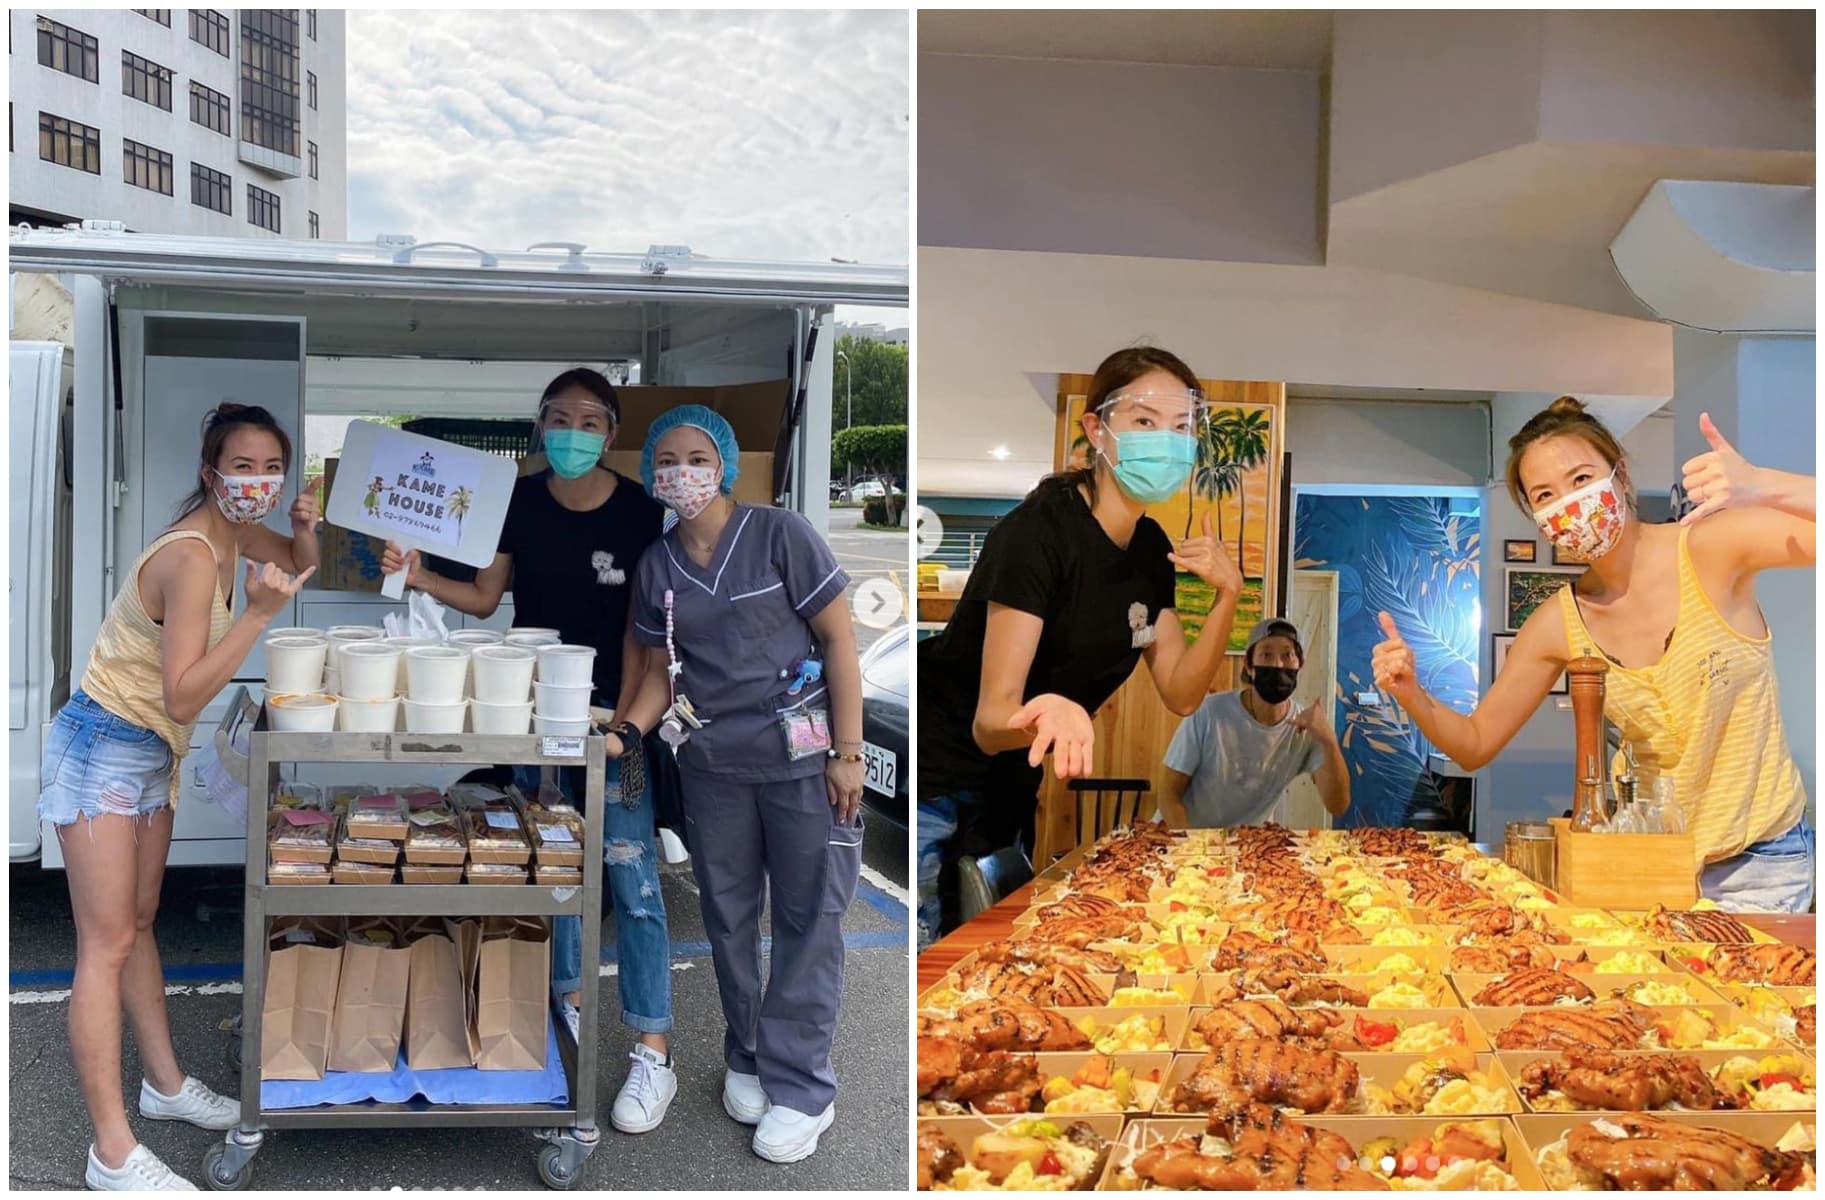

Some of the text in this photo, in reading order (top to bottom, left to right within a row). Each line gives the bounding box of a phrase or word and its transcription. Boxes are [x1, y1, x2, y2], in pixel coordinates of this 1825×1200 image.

[397, 473, 446, 498] KAME
[388, 492, 444, 519] HOUSE
[865, 753, 894, 789] 9512
